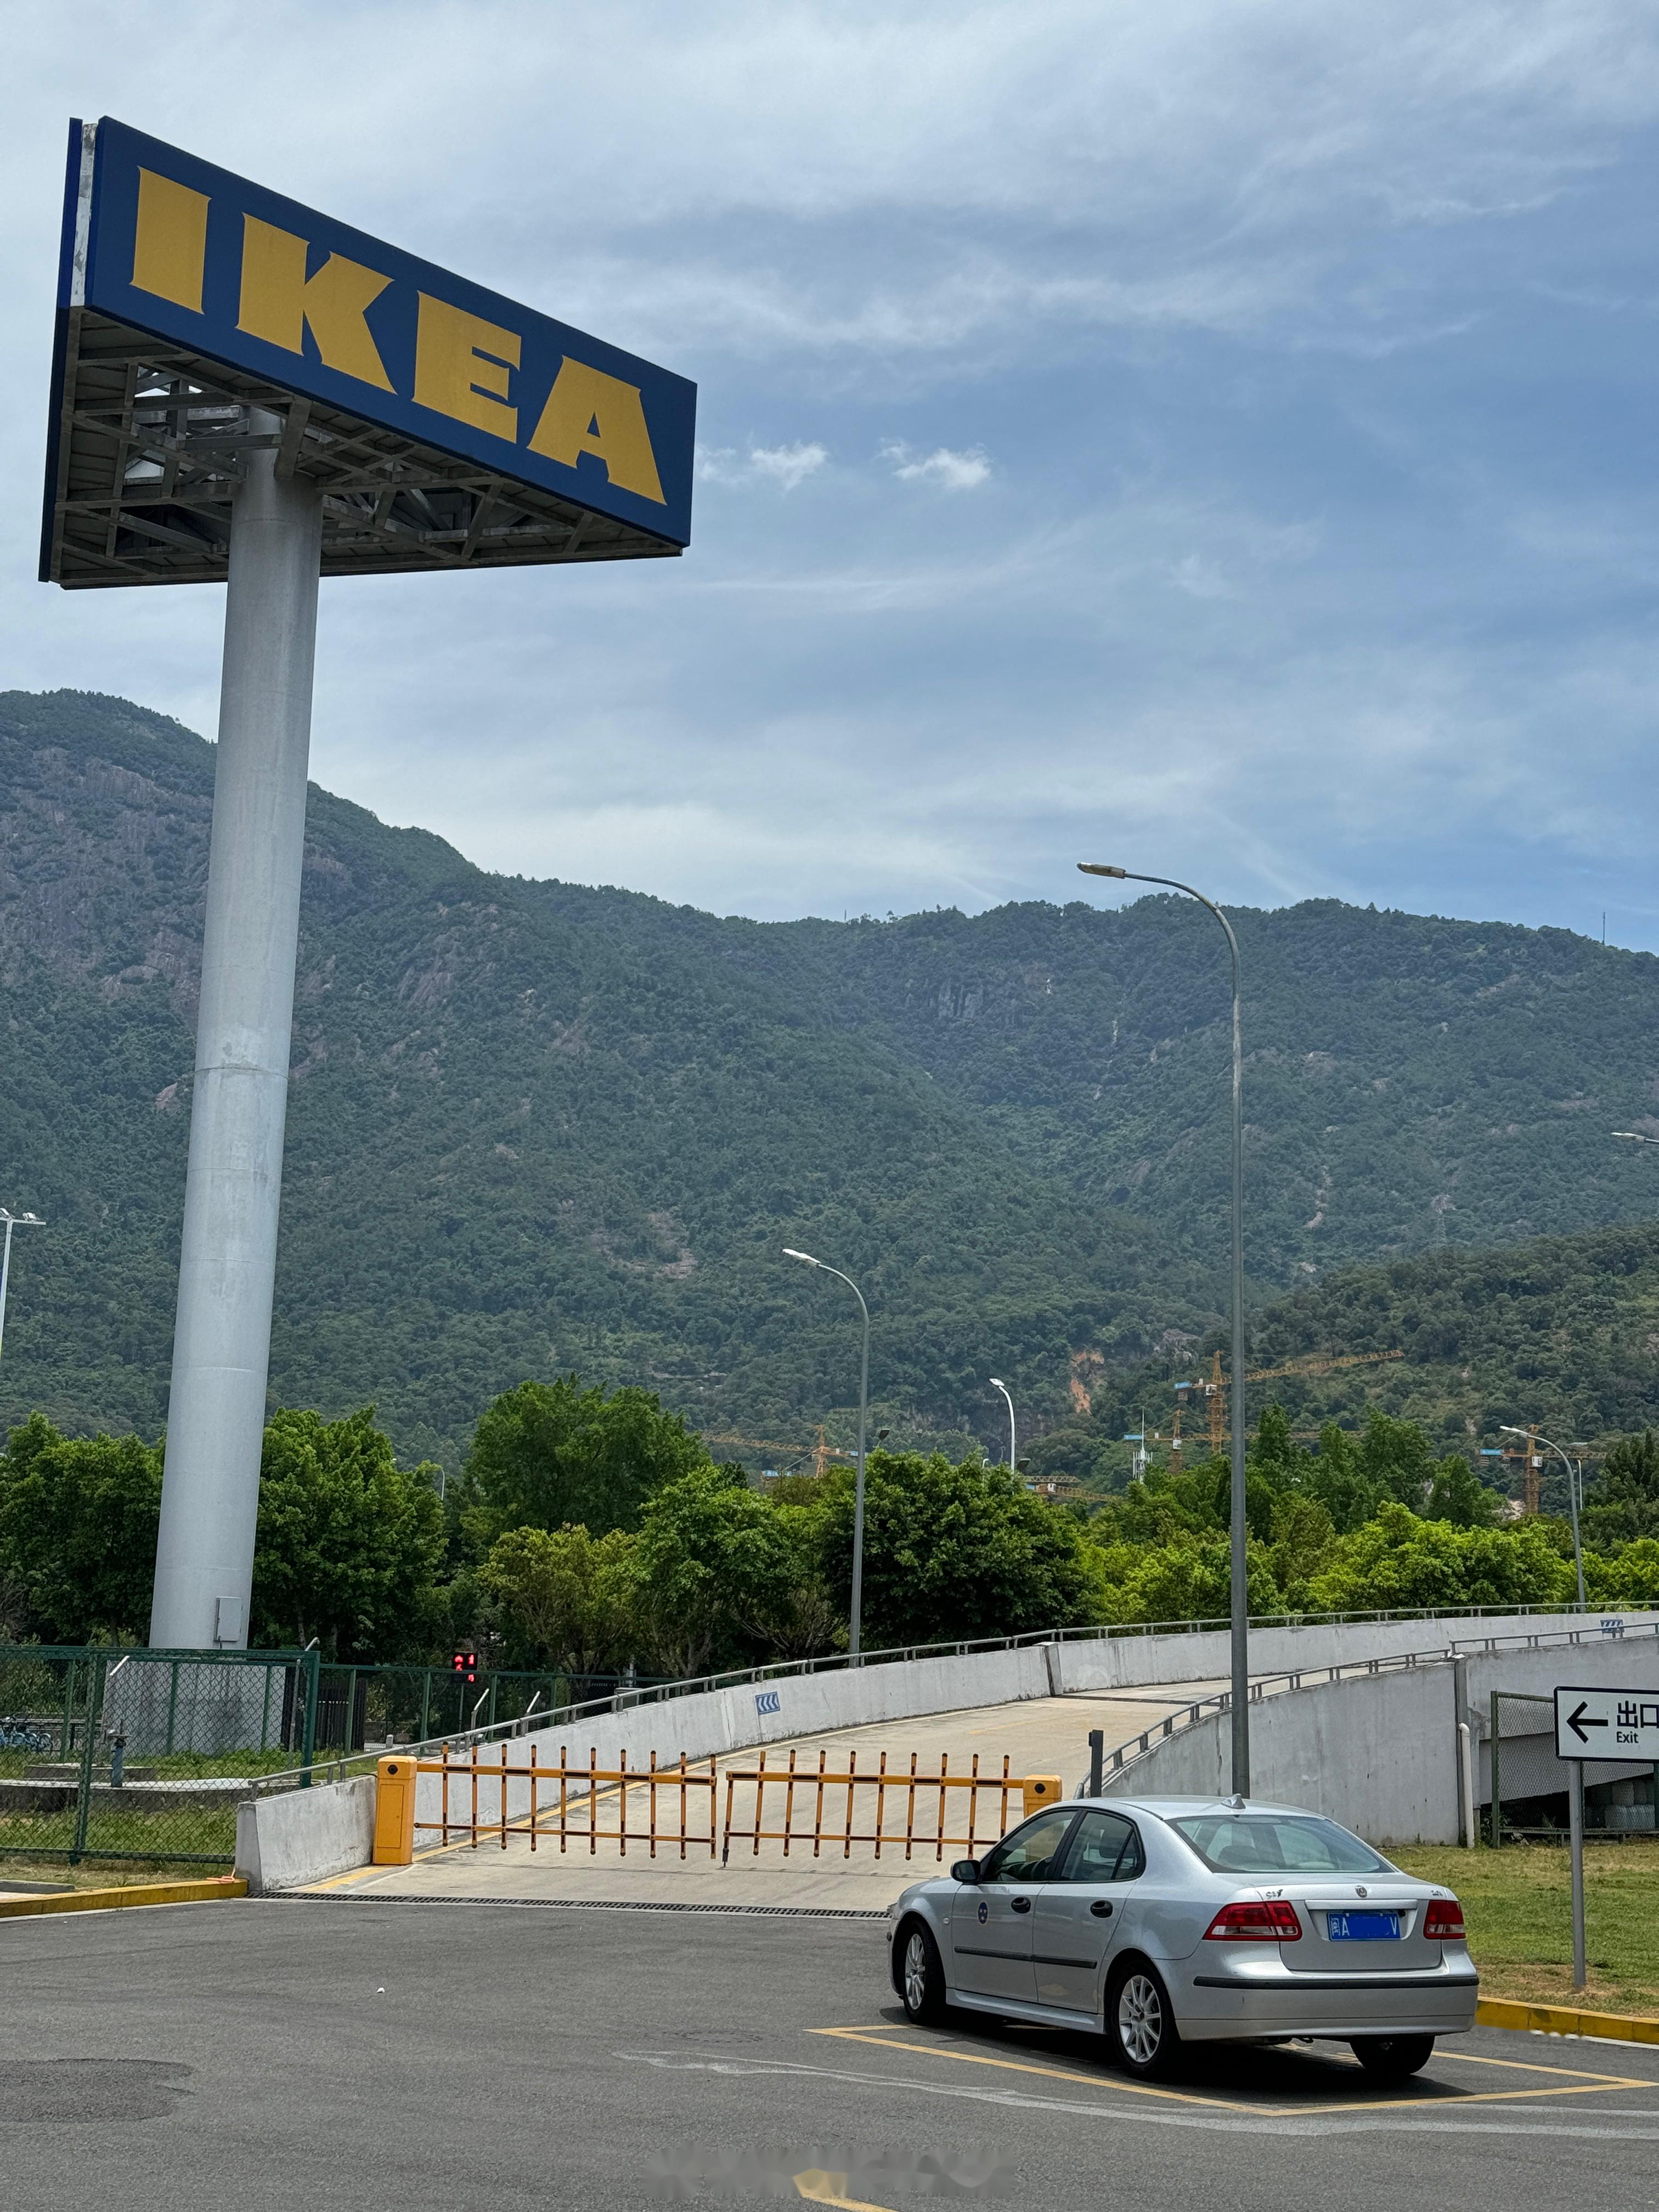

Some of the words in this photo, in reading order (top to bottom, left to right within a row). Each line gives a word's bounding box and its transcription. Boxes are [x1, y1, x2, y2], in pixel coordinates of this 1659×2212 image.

[129, 166, 667, 505] IKEA
[1617, 1700, 1659, 1728] 出口
[1616, 1731, 1639, 1743] Exit
